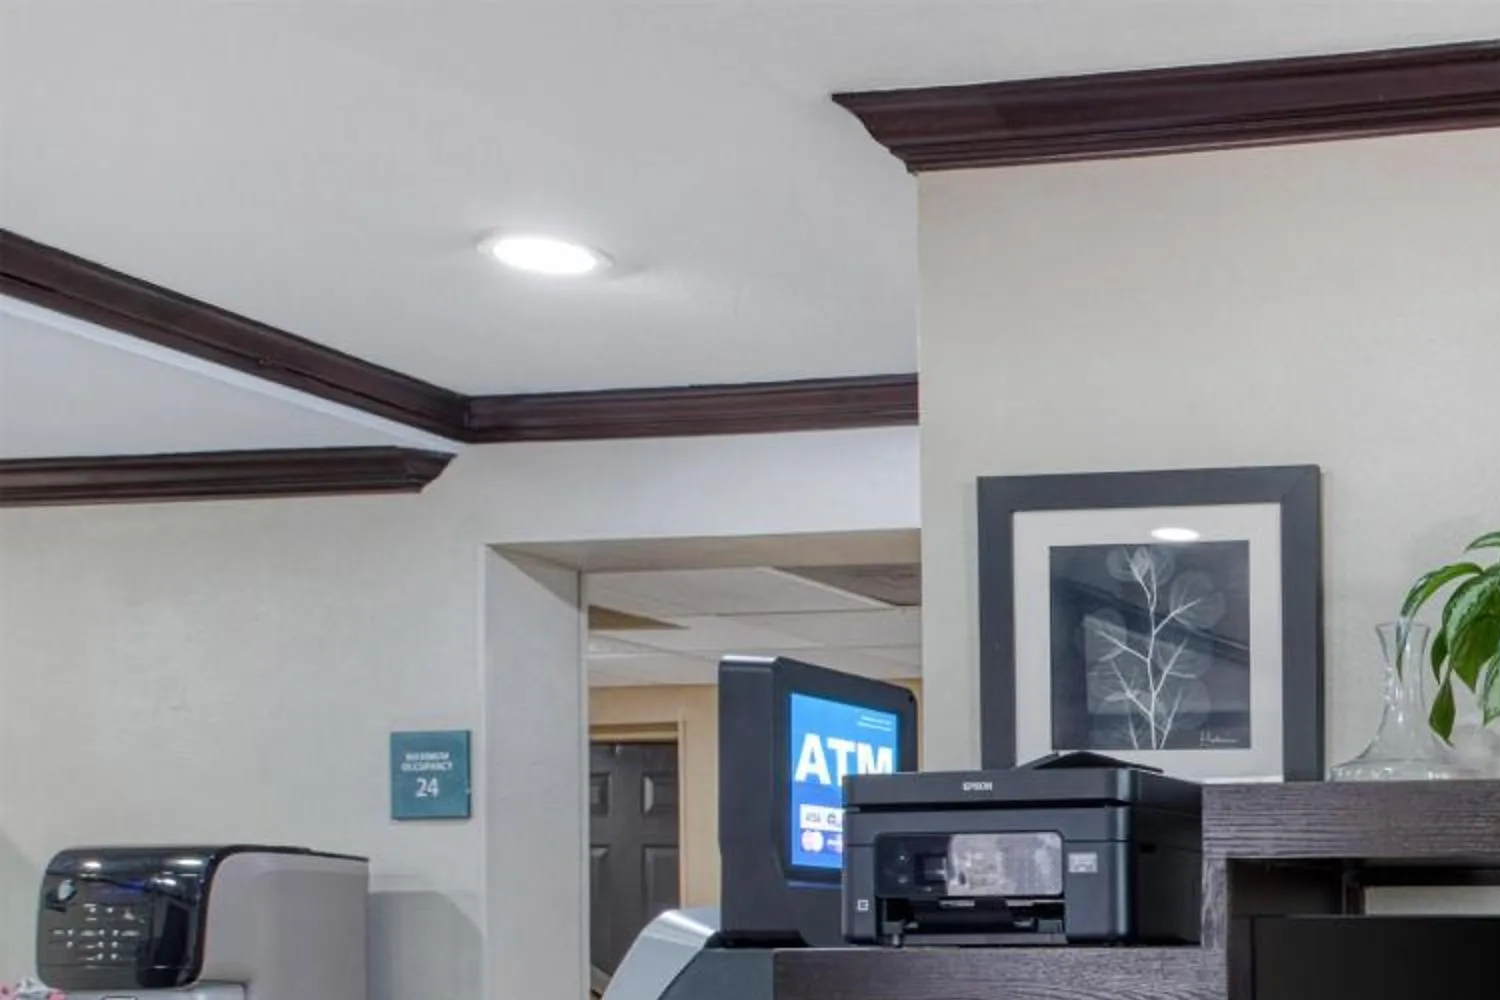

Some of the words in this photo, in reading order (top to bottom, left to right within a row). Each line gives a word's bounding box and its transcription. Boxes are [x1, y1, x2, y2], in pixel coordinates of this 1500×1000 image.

[401, 760, 453, 772] OCCUPANCY
[794, 731, 894, 787] ATM
[415, 777, 439, 797] 24
[962, 781, 993, 791] EPSON
